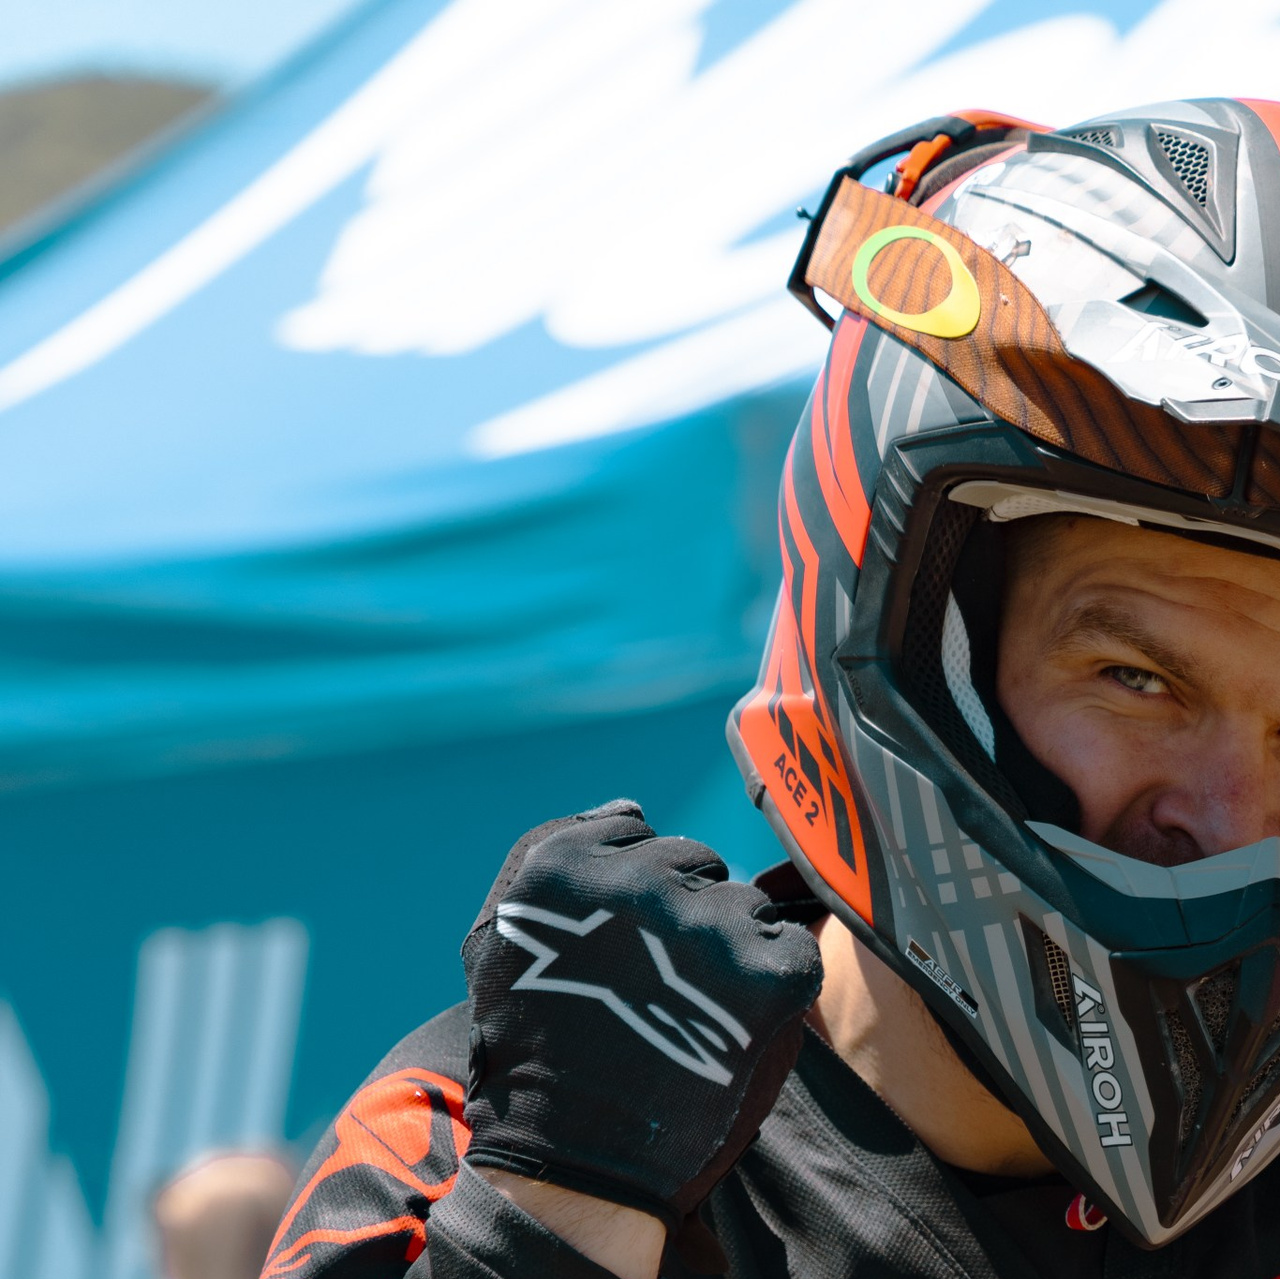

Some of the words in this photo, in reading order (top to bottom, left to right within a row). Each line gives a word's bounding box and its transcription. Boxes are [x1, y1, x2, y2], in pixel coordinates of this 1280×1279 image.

[774, 753, 808, 808] ACE
[804, 802, 820, 827] 2
[907, 950, 955, 996] EMERGENCY
[955, 995, 976, 1015] ONLY
[924, 959, 963, 995] AEFR
[1071, 972, 1133, 1148] AIROH
